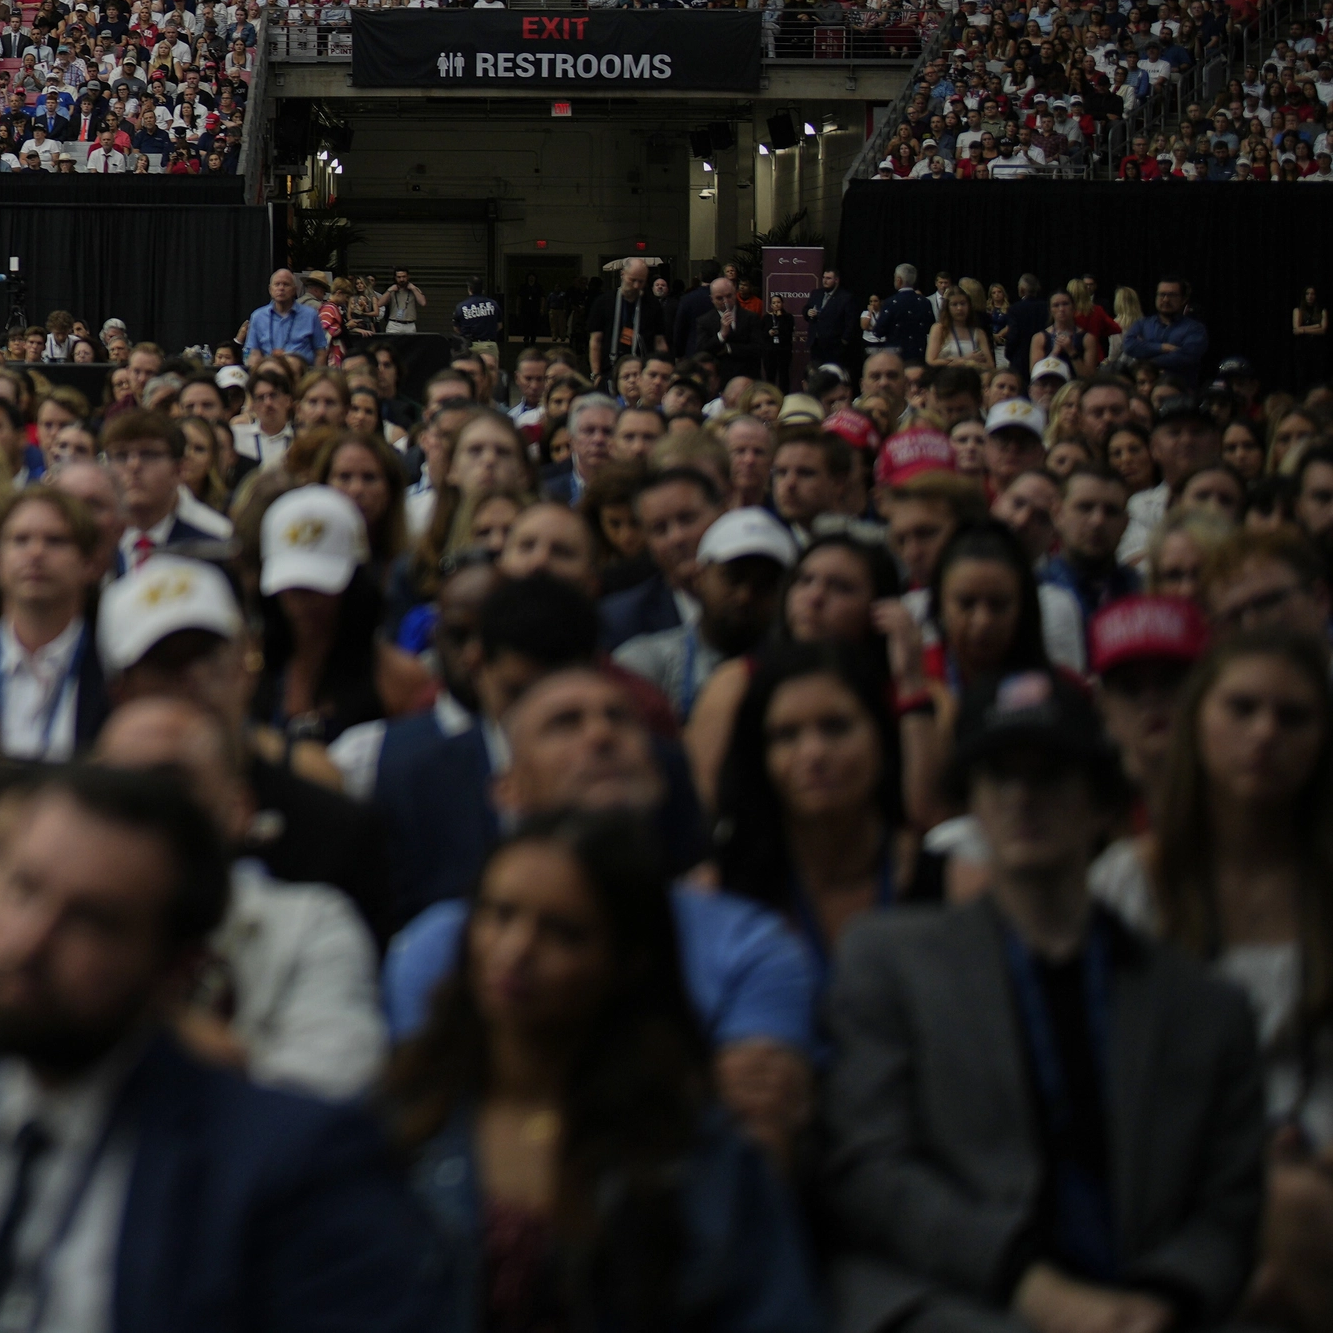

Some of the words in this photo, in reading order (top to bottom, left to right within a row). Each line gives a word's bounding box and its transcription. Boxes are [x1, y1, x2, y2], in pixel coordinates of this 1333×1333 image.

[521, 16, 589, 40] EXIT
[475, 52, 672, 79] RESTROOMS
[463, 307, 495, 320] SECURITY
